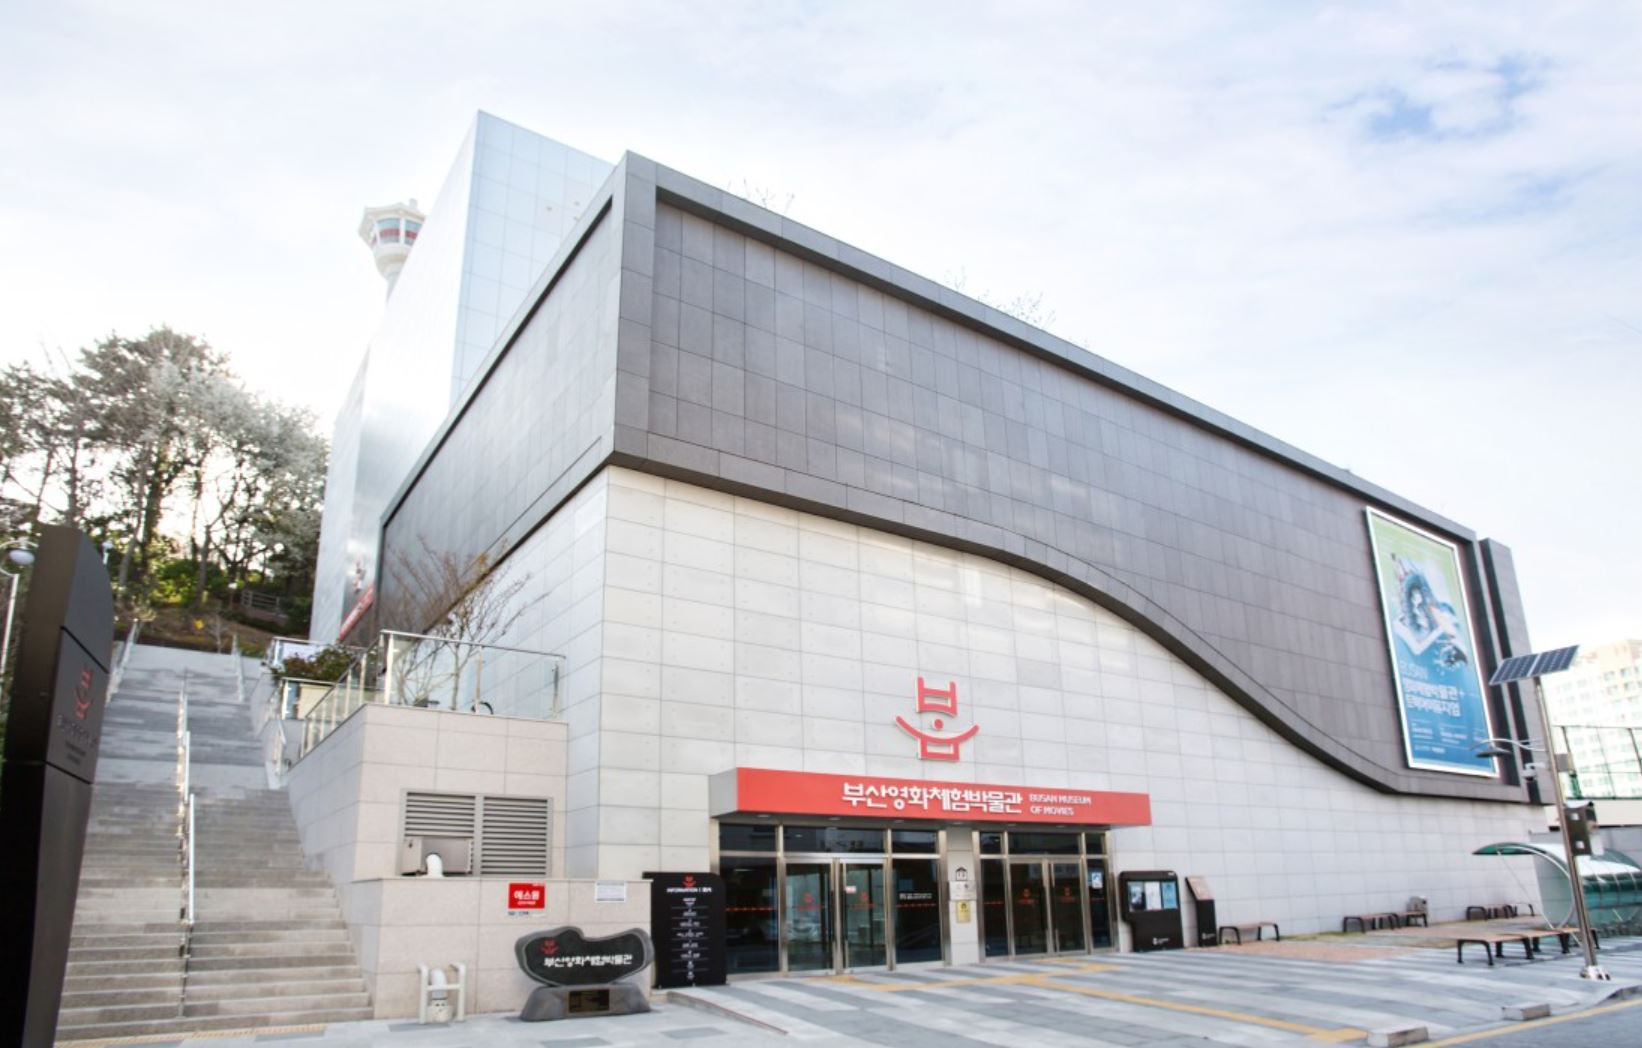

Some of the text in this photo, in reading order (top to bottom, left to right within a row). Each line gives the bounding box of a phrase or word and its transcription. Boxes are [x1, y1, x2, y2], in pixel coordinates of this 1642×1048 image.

[842, 783, 1022, 813] 부산영화체험박물관
[1029, 794, 1091, 805] BUSAN MUSEUM
[1030, 805, 1074, 816] OF MOVIES
